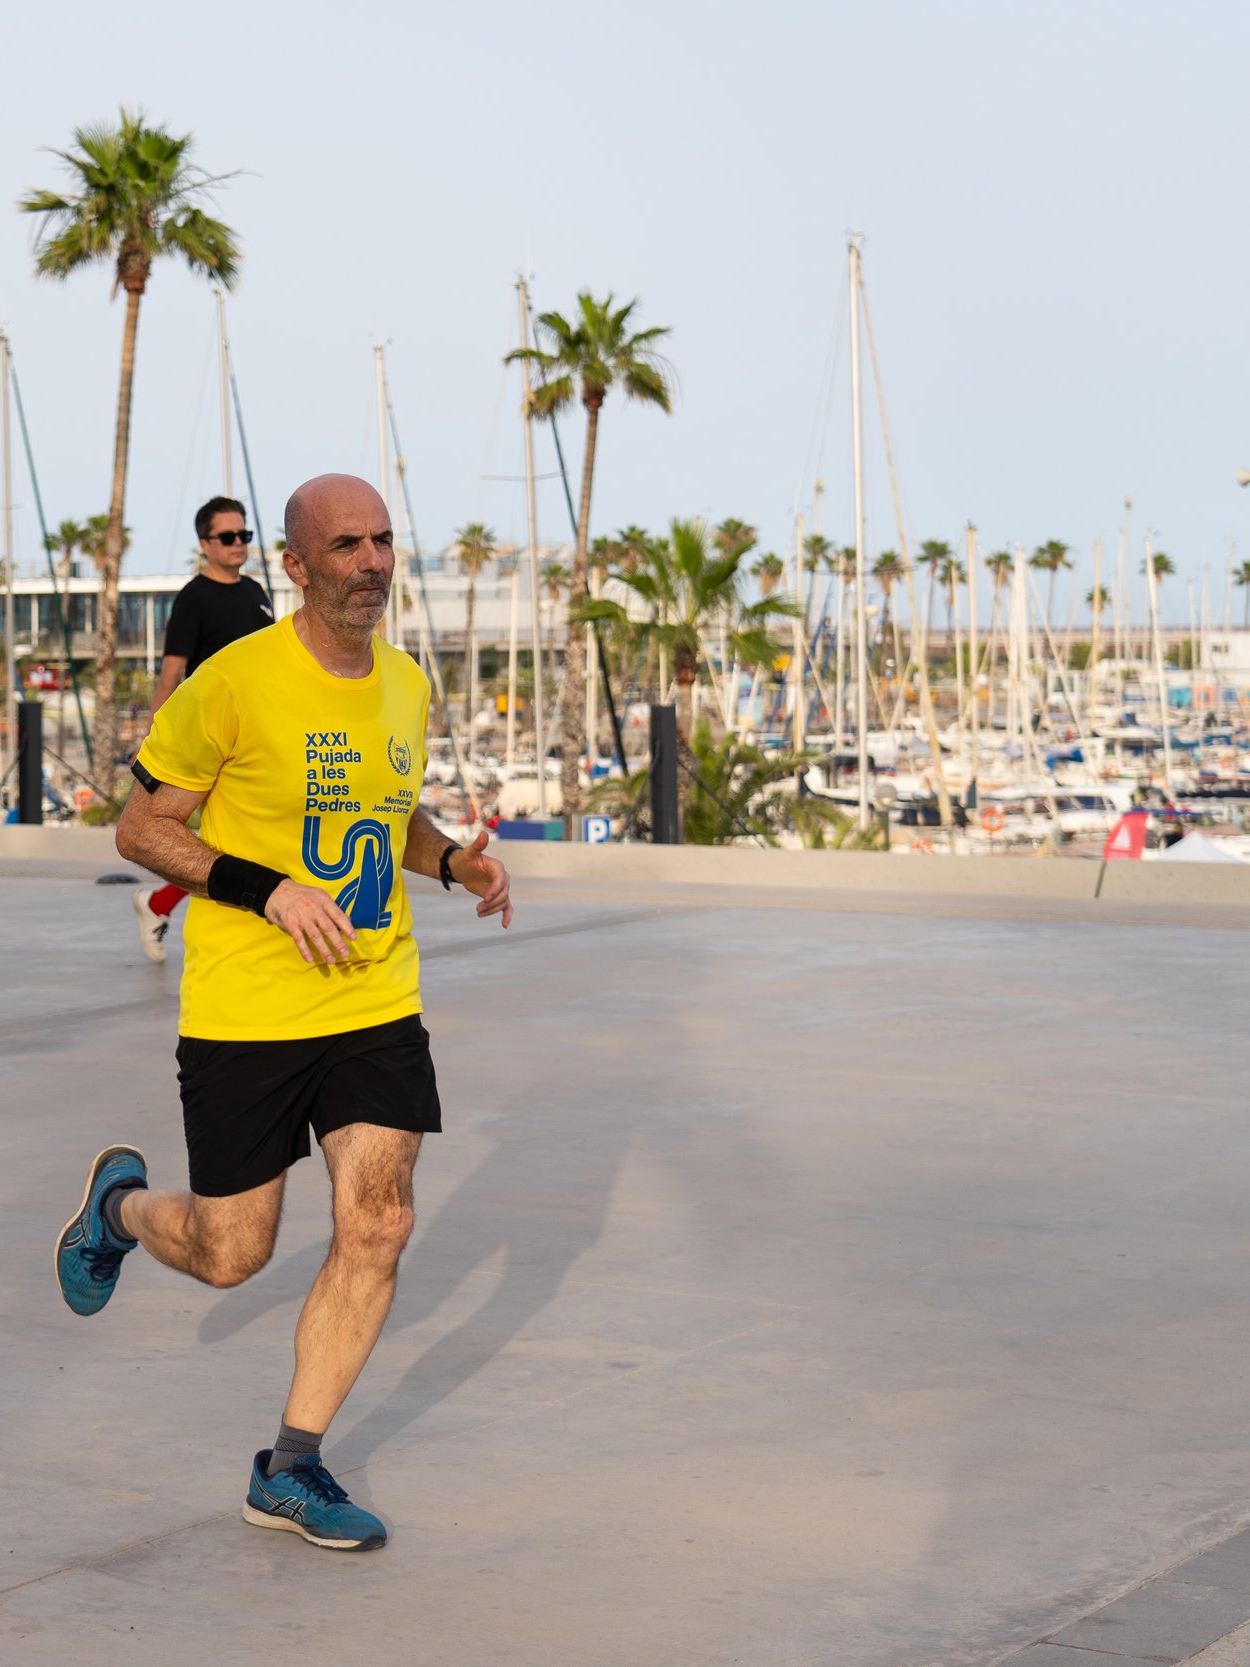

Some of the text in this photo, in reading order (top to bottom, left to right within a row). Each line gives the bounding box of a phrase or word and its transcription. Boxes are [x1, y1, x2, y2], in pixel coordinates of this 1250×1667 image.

[305, 732, 347, 747] XXXI
[306, 749, 361, 765] Pujada
[306, 765, 346, 779] a les
[306, 781, 350, 796] Dues
[305, 798, 361, 812] Pedres
[372, 804, 391, 813] Josep
[588, 818, 607, 843] P
